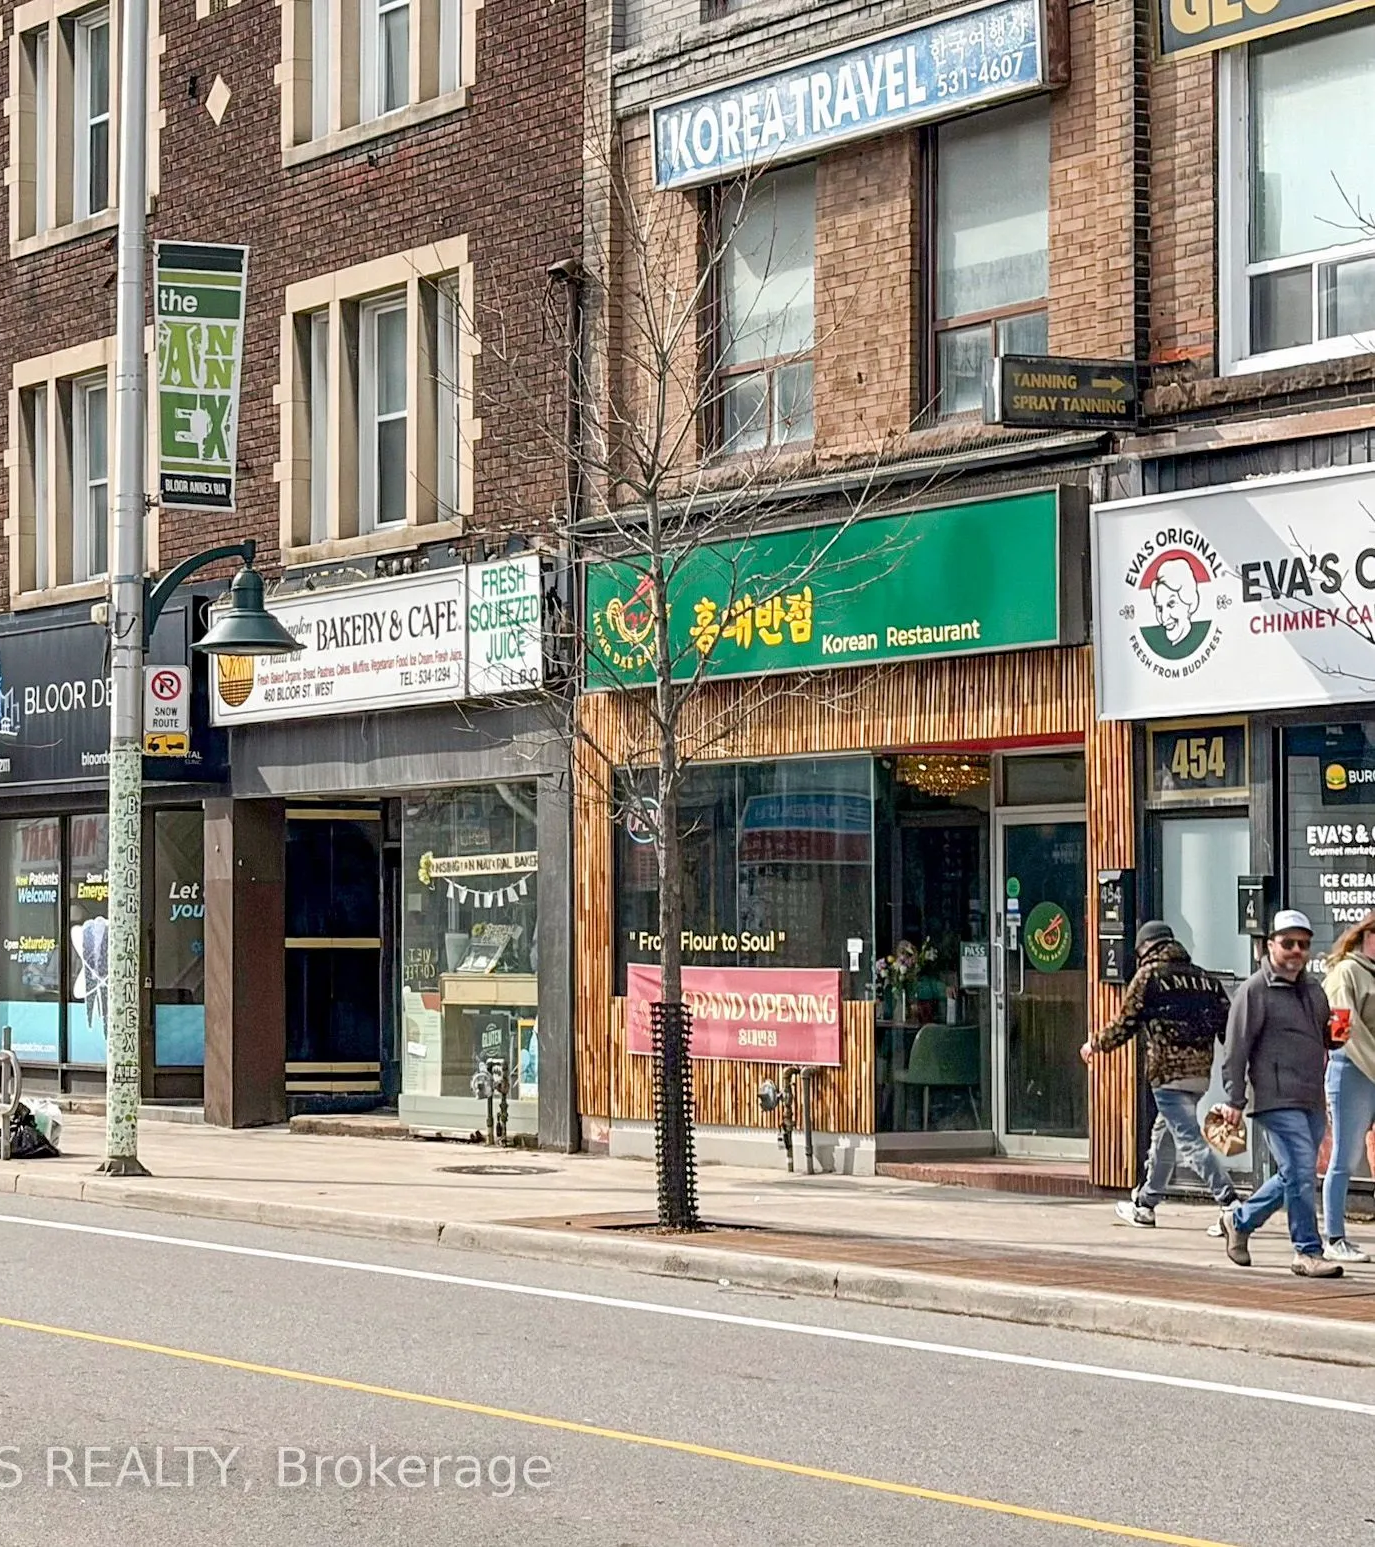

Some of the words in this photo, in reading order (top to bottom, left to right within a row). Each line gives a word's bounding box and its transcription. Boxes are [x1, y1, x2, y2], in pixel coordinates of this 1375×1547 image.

[937, 51, 1024, 98] 531-4607
[670, 87, 787, 173] KOREA
[789, 45, 927, 137] TRAVEL
[160, 289, 198, 313] the
[1012, 372, 1078, 390] TANNING
[1012, 395, 1058, 411] SPRAY
[1062, 399, 1126, 414] TANNING
[165, 478, 189, 494] BLOOR
[190, 480, 212, 495] ANNEX
[1125, 541, 1154, 587] EVA'S
[1155, 528, 1223, 578] ORIGINAL
[481, 563, 526, 597] FRESH
[1241, 552, 1342, 603] EVA'S
[469, 594, 540, 633] SQUEEZED
[689, 585, 813, 654] 홍대반점
[1249, 607, 1340, 635] CHIMNEY
[316, 611, 387, 651] BAKERY
[389, 609, 402, 642] &
[821, 632, 878, 655] Korean
[886, 619, 981, 648] Restaurant
[485, 629, 526, 664] JUICE
[1129, 635, 1152, 669] FRESH
[1153, 664, 1180, 679] FROM
[1182, 626, 1223, 677] BUDAPEST
[418, 667, 451, 685] 534-1294
[24, 680, 86, 715] BLOOR
[264, 688, 276, 702] 460
[277, 685, 300, 701] BLOOR
[314, 681, 334, 697] WEST
[155, 706, 178, 717] SNOW
[153, 718, 180, 728] ROUTE
[1171, 736, 1225, 780] 454
[1306, 824, 1353, 845] EVA'S
[1354, 824, 1370, 844] &
[126, 795, 137, 914] BLOOR
[1308, 845, 1344, 857] Gourmet
[29, 872, 59, 886] Patients
[1320, 873, 1340, 888] ICE
[1340, 873, 1375, 888] CREA
[18, 887, 57, 903] Welcome
[169, 881, 199, 899] Let
[1324, 890, 1375, 905] BURGER
[1246, 900, 1255, 918] 4
[19, 936, 56, 951] Saturdays
[639, 932, 662, 951] Fro
[680, 930, 718, 951] Flour
[721, 933, 737, 951] to
[740, 931, 775, 952] Soul
[964, 946, 986, 957] PASS
[18, 952, 48, 965] Evenings
[1107, 950, 1116, 966] 2
[124, 933, 137, 1053] ANNEX
[682, 991, 746, 1020] GRAND
[748, 993, 837, 1024] OPENING
[481, 1029, 502, 1048] GLUTEN
